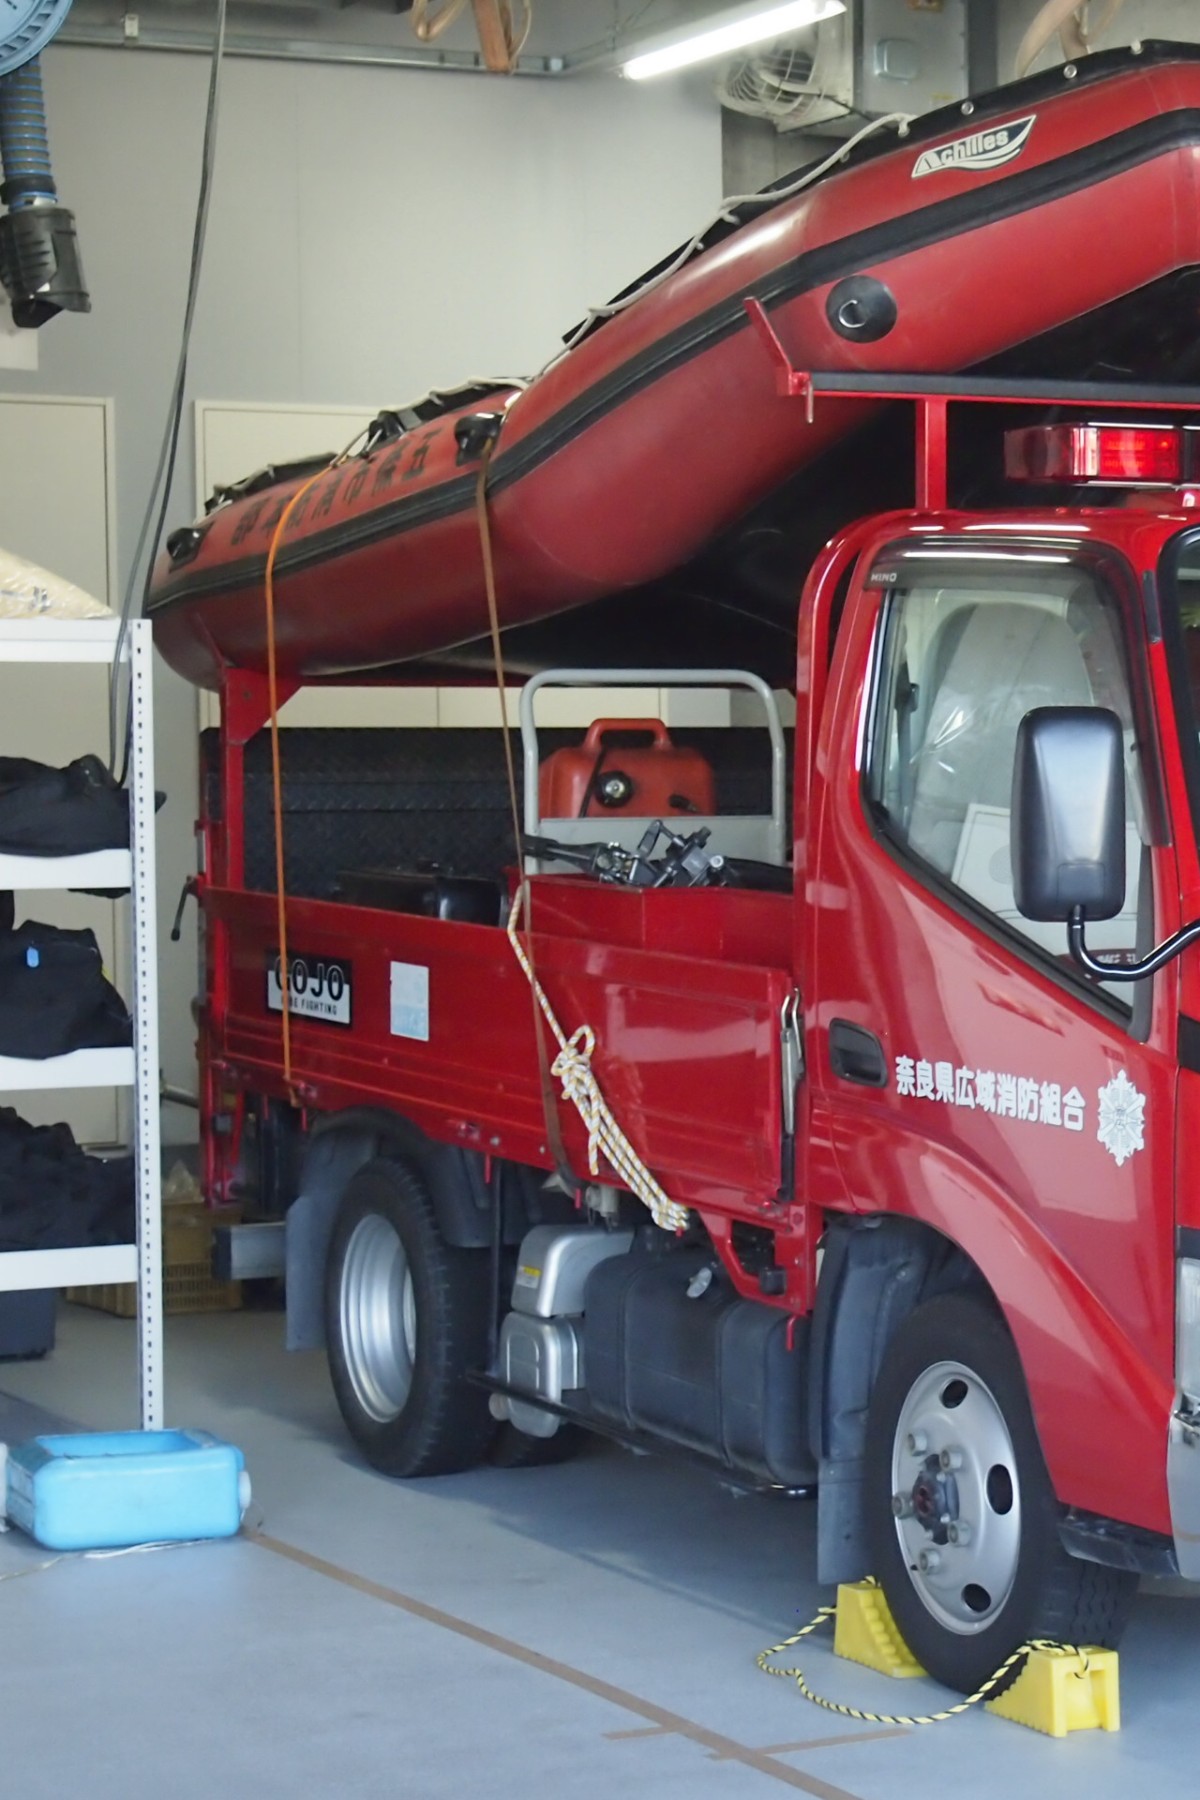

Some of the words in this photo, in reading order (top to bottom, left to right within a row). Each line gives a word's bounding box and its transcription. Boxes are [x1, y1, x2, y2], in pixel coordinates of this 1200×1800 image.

[914, 130, 1009, 174] Achilles
[870, 572, 898, 583] HINO
[301, 998, 337, 1016] FIGHTING
[895, 1054, 1086, 1131] 奈良県広域消防組合
